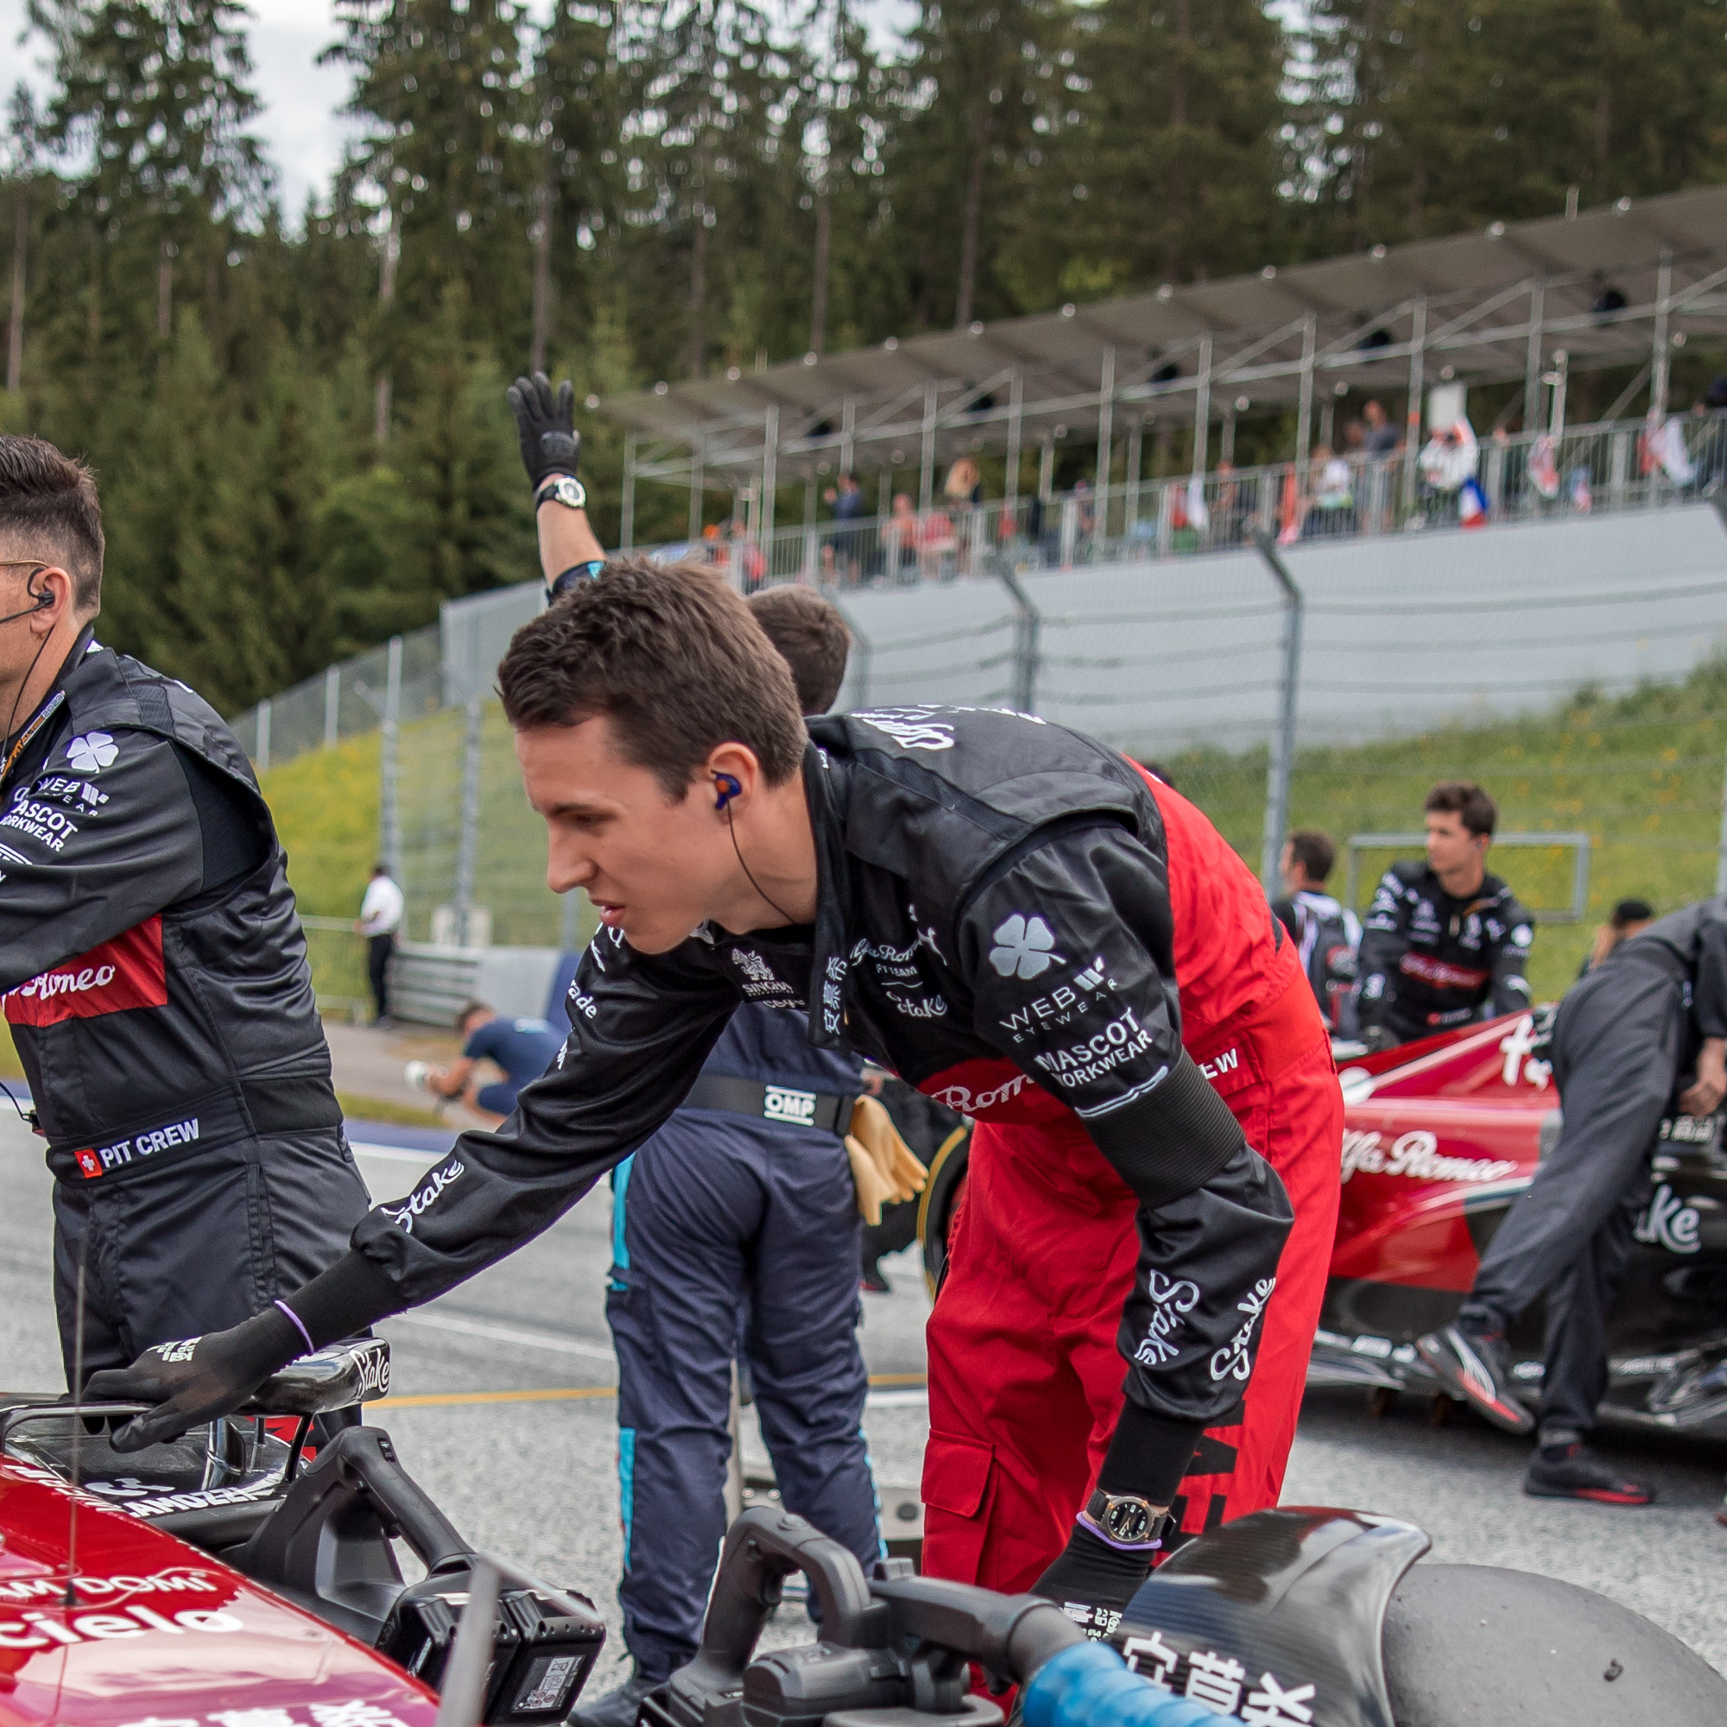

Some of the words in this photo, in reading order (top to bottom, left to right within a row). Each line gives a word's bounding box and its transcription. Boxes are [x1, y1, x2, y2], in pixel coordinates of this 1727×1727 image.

[12, 799, 78, 840] ASCOT
[741, 978, 794, 997] SINGHA
[998, 984, 1076, 1032] WEB
[1012, 977, 1119, 1045] EYEWEAR
[1033, 1006, 1140, 1073] MASCOT
[1198, 1047, 1239, 1080] EW
[765, 1095, 816, 1118] OMP
[932, 1071, 1037, 1113] Rom
[99, 1140, 133, 1169] PIT
[135, 1117, 201, 1156] CREW
[1342, 1127, 1386, 1185] lfa
[1383, 1129, 1519, 1182] Romeo
[1134, 1268, 1201, 1366] Stake
[1210, 1277, 1277, 1381] Stake
[130, 1484, 262, 1519] AMOZZI
[73, 1571, 219, 1595] DOMI
